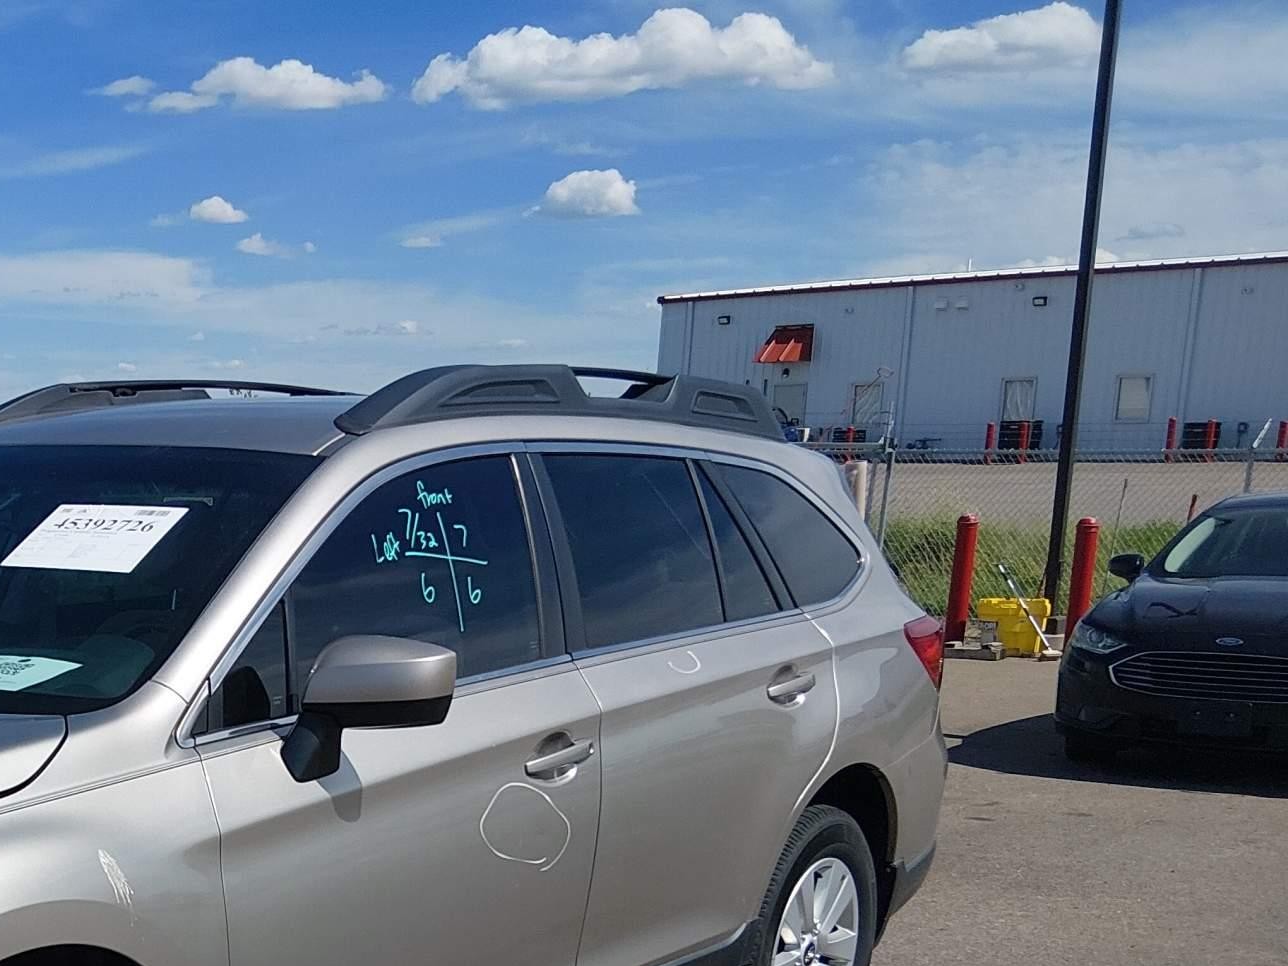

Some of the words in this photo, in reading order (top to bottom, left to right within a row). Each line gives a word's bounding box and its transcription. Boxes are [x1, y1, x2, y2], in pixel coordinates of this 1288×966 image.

[53, 517, 156, 533] 45392726
[453, 524, 467, 548] 7
[421, 572, 436, 603] 6
[467, 576, 482, 605] 6
